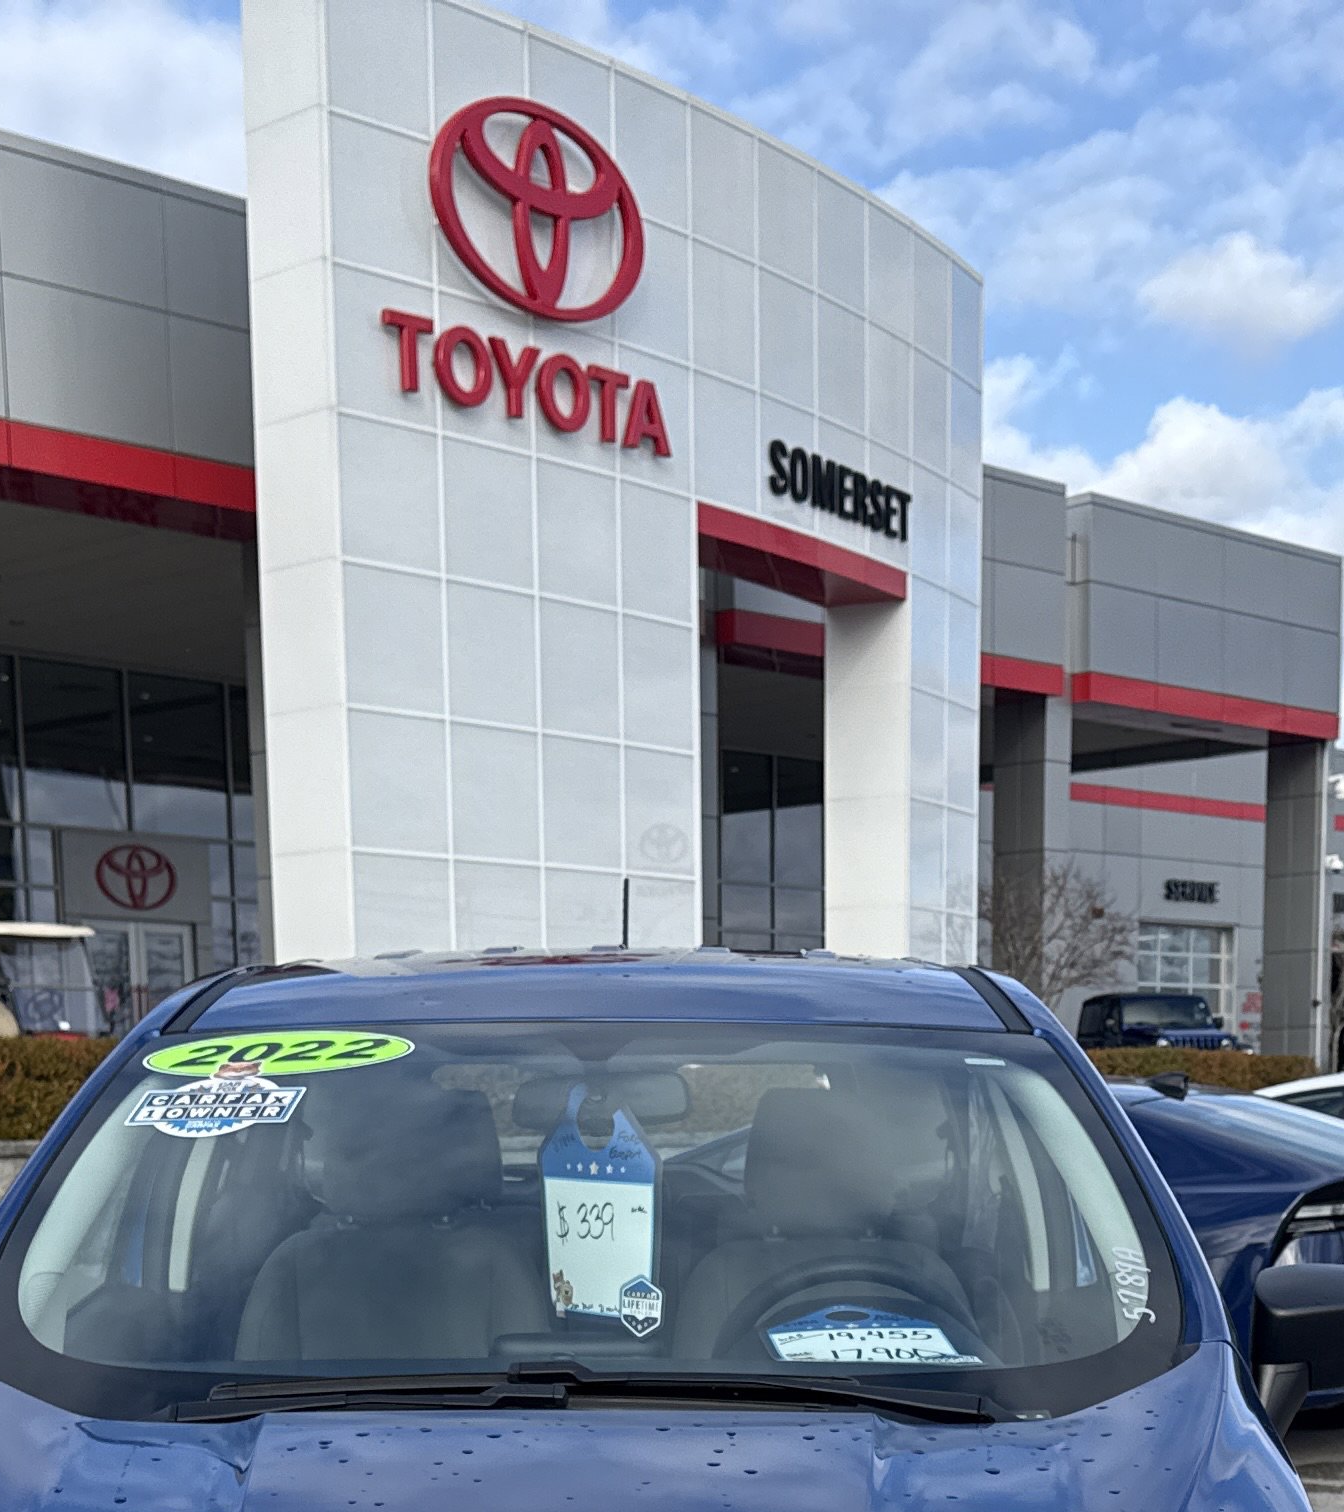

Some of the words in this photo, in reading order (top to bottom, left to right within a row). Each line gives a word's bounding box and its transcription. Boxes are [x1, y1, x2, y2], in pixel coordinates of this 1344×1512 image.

[381, 308, 672, 457] TOYOTA
[767, 439, 912, 542] SOMERSET
[168, 1038, 391, 1069] 2022
[151, 1092, 289, 1106] CARFAX
[164, 1105, 283, 1119] OWNER
[1112, 1246, 1156, 1324] 5789A
[623, 1298, 659, 1312] LIFETIME
